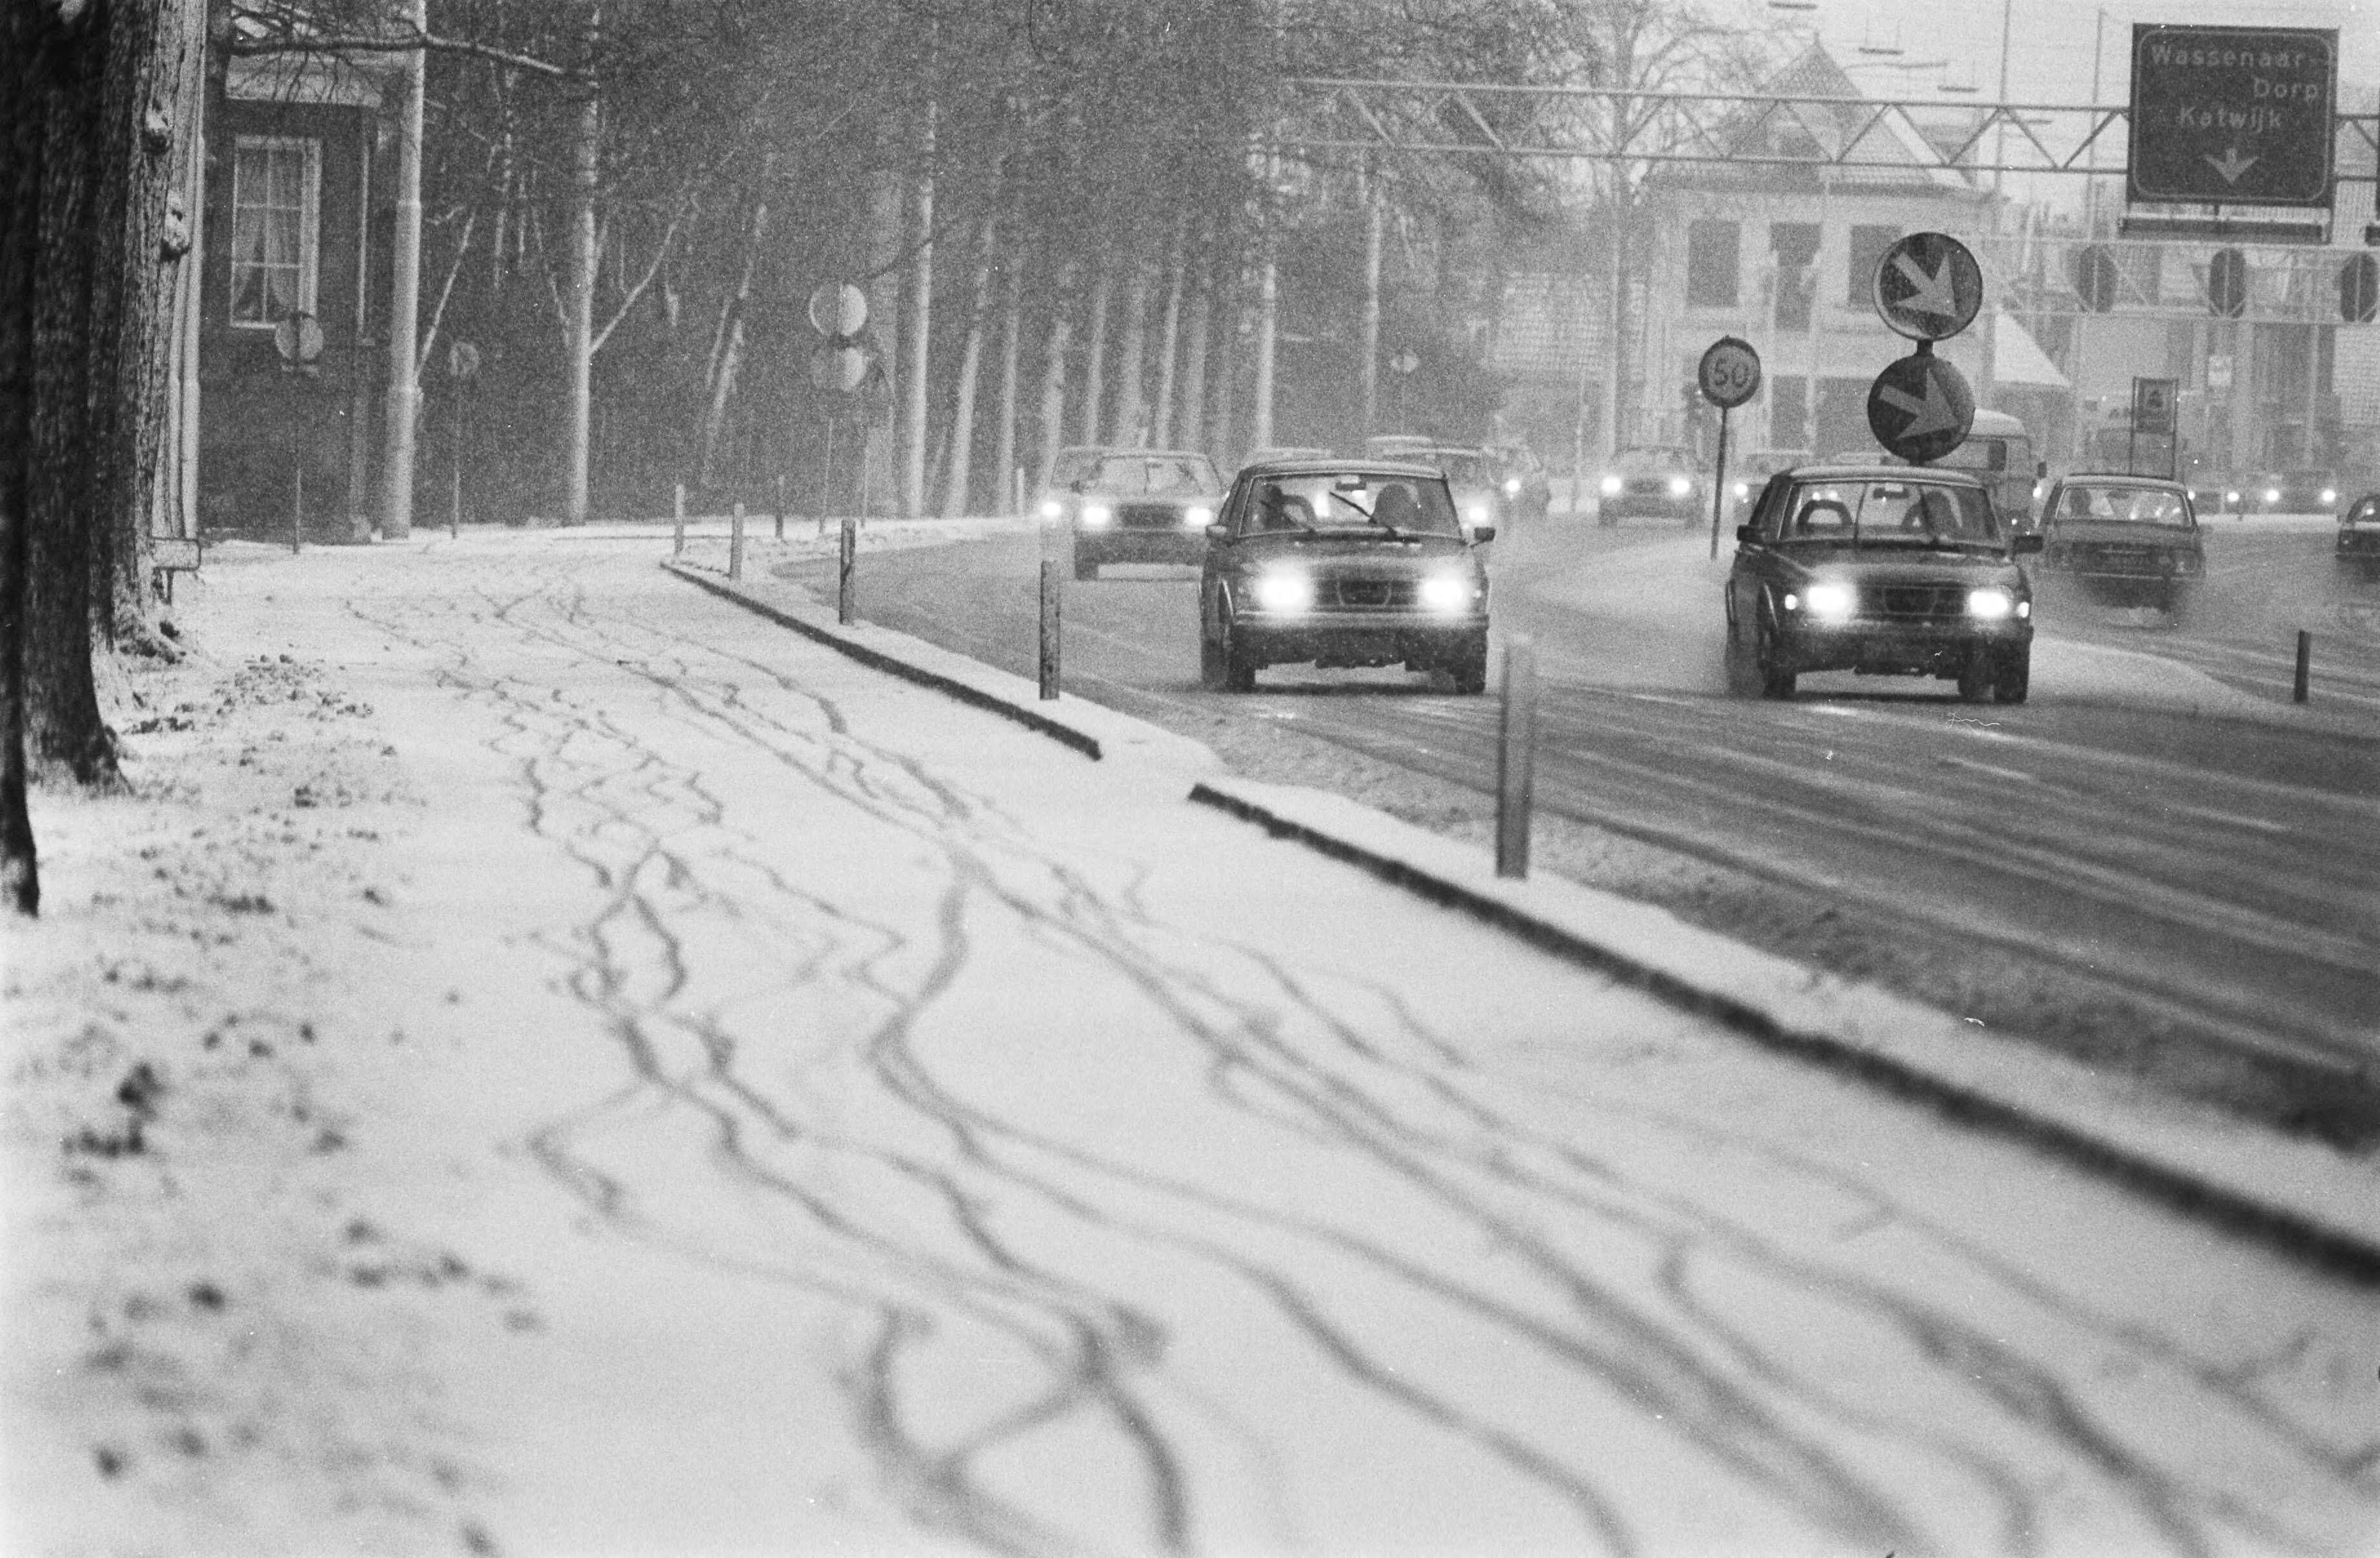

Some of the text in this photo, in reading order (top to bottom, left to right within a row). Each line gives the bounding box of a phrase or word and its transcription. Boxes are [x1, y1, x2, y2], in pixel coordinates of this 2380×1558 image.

[2254, 77, 2319, 103] Dorp
[2179, 106, 2282, 133] Katwijk
[1715, 358, 1748, 388] 50
